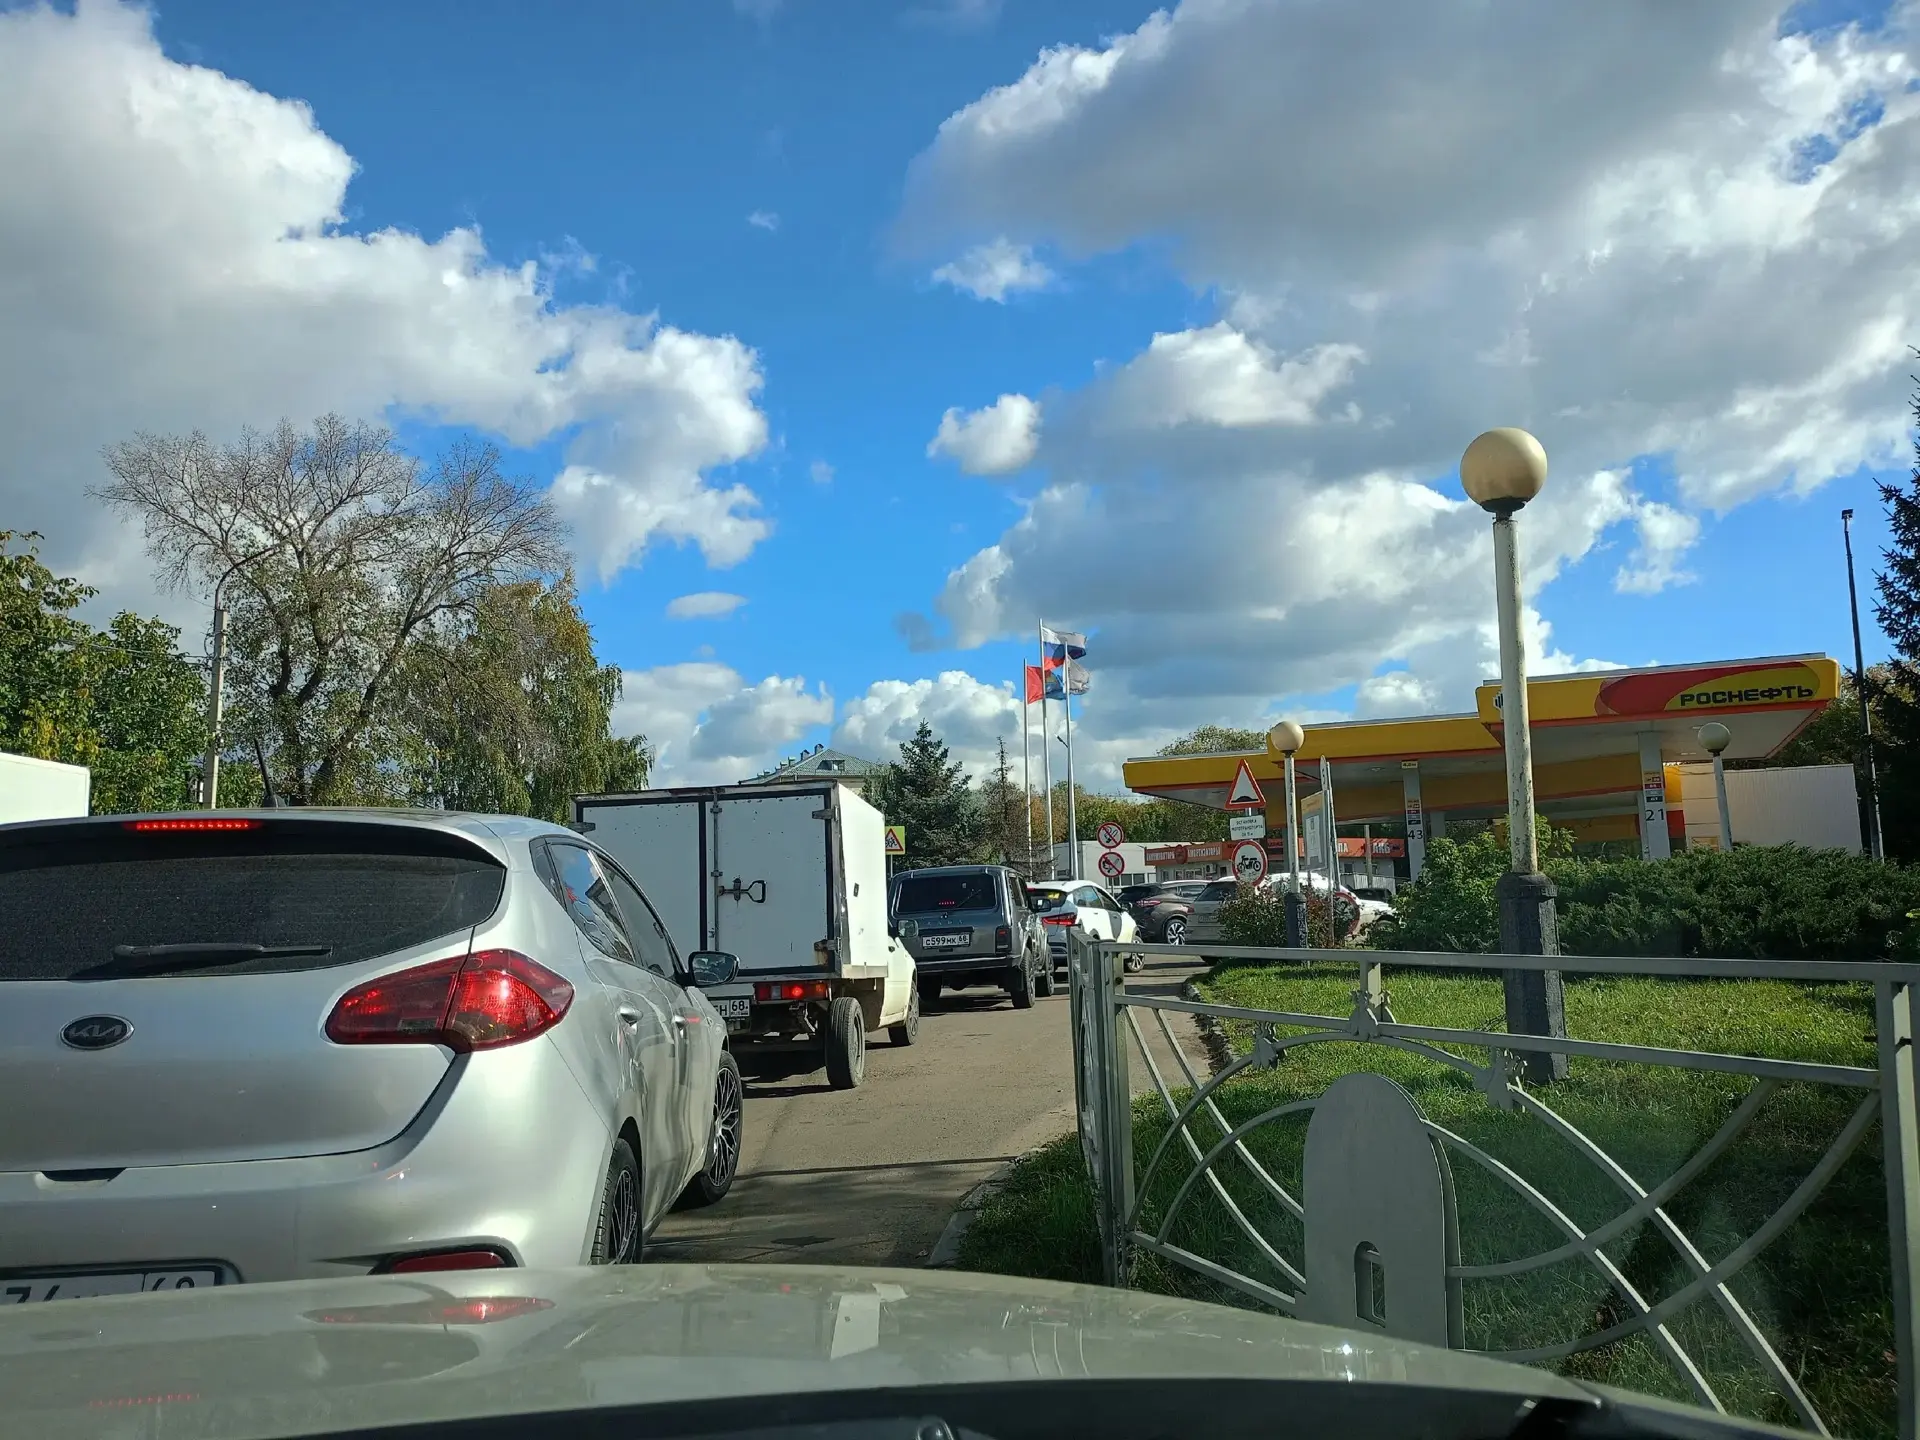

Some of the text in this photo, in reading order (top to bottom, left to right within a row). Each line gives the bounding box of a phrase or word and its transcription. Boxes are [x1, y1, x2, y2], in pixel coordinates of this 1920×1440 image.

[1680, 685, 1813, 706] РОСНЕФТЬ
[1645, 809, 1665, 821] 21
[1408, 829, 1424, 840] 43
[68, 1024, 123, 1037] KIA
